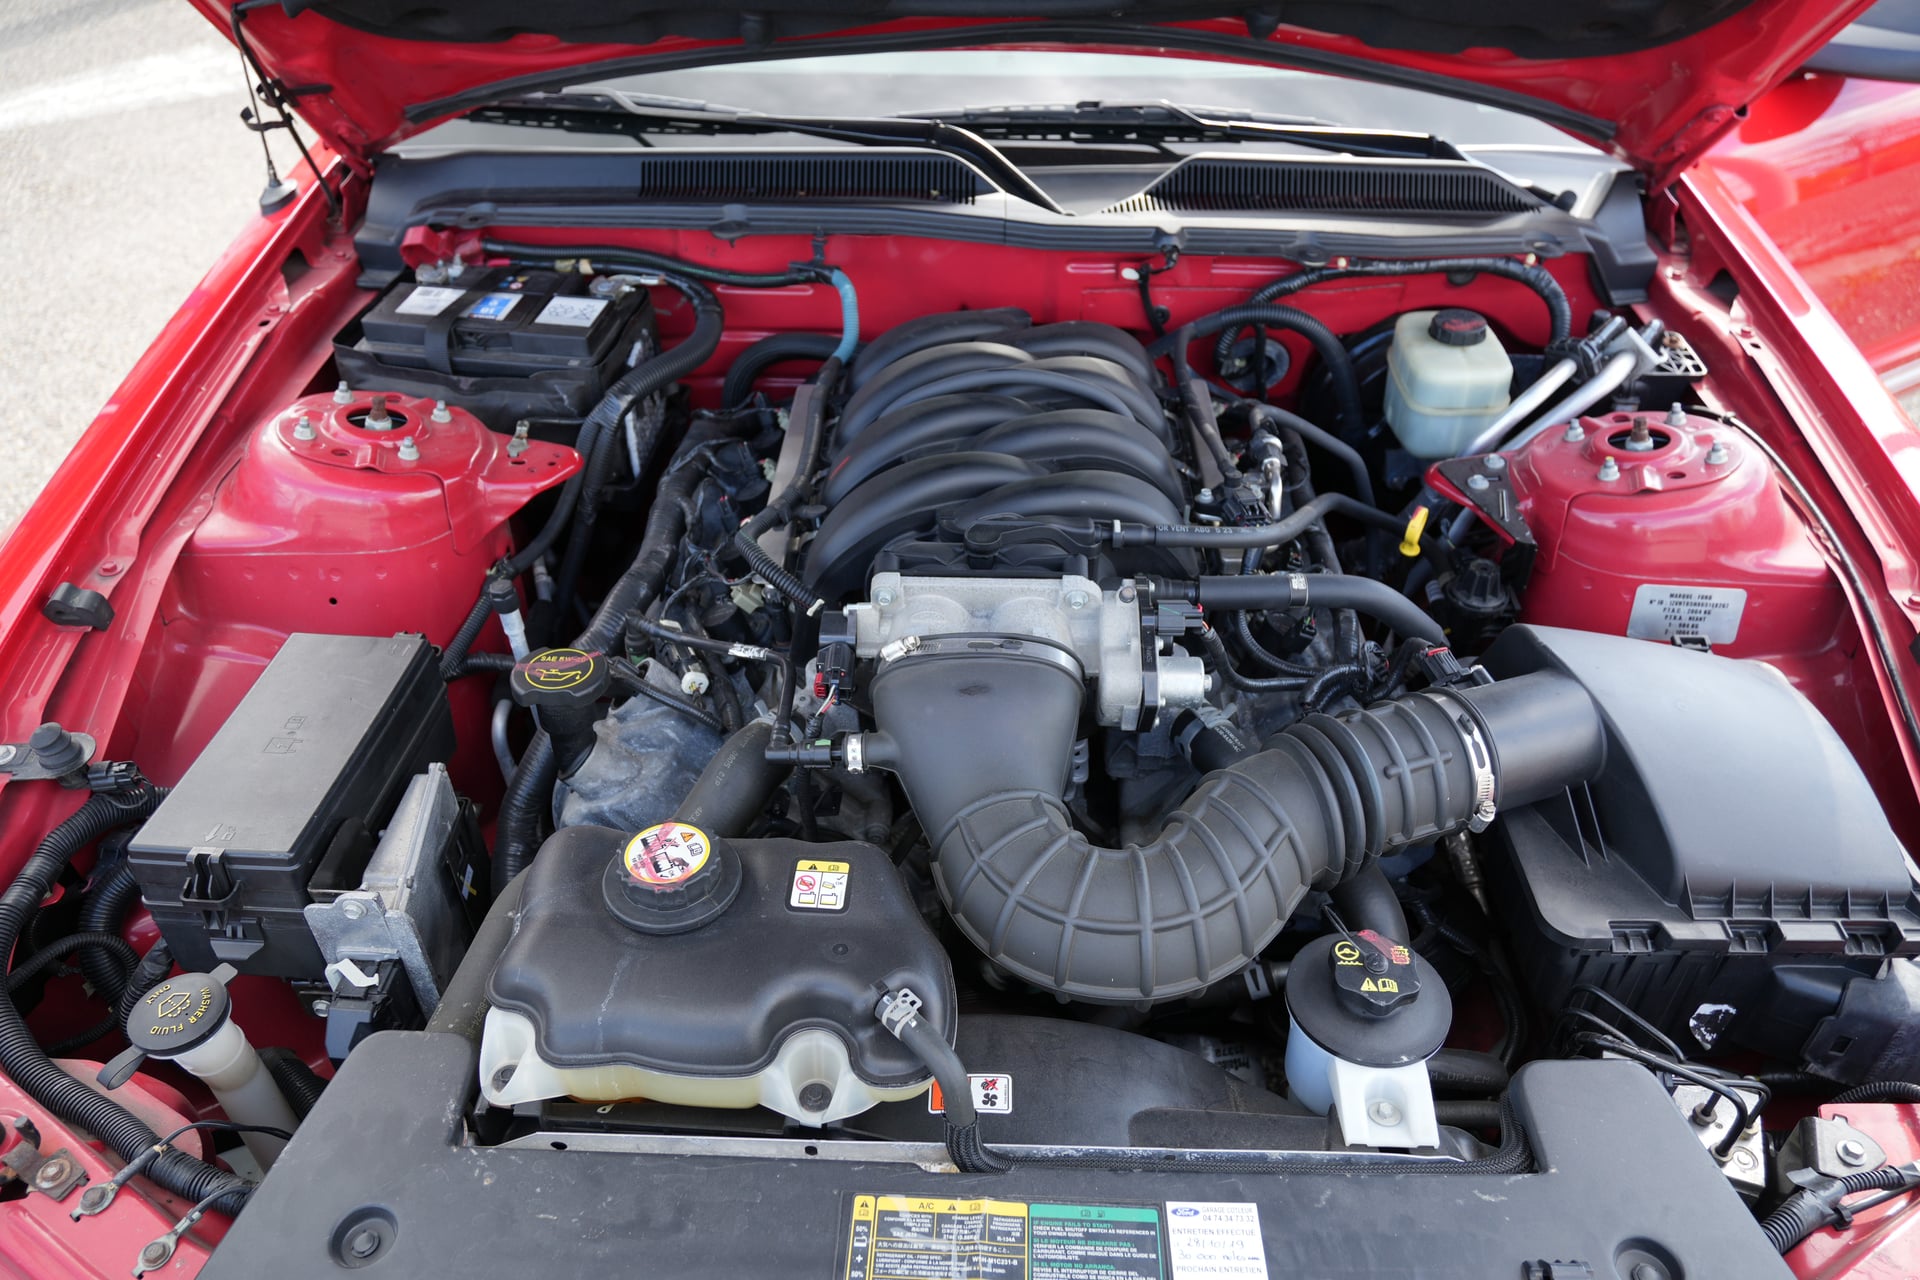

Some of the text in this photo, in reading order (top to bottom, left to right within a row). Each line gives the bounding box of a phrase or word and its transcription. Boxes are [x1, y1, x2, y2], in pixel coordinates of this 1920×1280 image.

[145, 984, 171, 1005] ONLY
[188, 986, 211, 1024] WASHER
[150, 1023, 184, 1034] FLUID
[918, 1202, 935, 1210] A/C
[1202, 1214, 1211, 1222] 04
[1214, 1214, 1223, 1222] 74
[1172, 1227, 1214, 1236] ENTRETIEN
[1176, 1265, 1262, 1274] PROCHAIN ENTRETIEN
